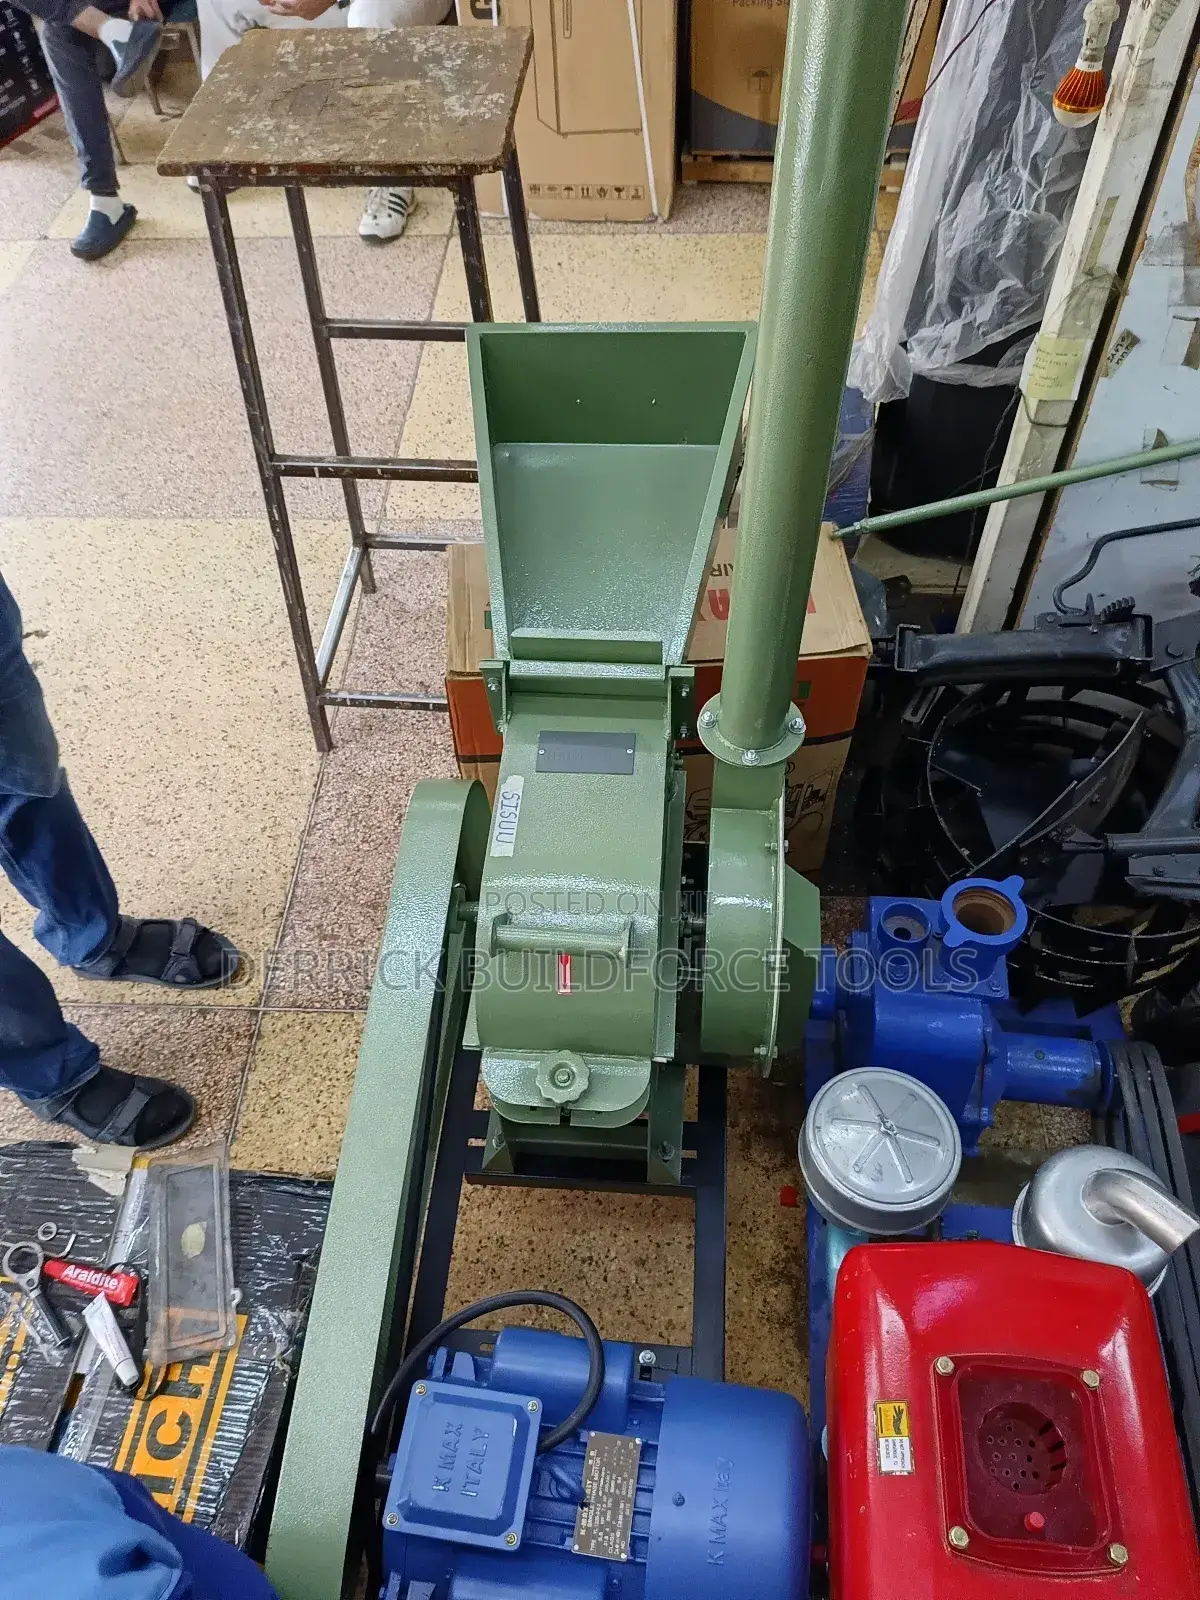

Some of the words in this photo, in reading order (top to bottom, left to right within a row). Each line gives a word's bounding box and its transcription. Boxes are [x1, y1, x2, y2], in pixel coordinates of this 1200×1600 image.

[61, 1264, 118, 1290] Araldite
[438, 1422, 463, 1470] MAX
[460, 1426, 489, 1497] ITALY
[587, 1503, 595, 1528] SINGLE
[708, 1498, 728, 1545] MAX
